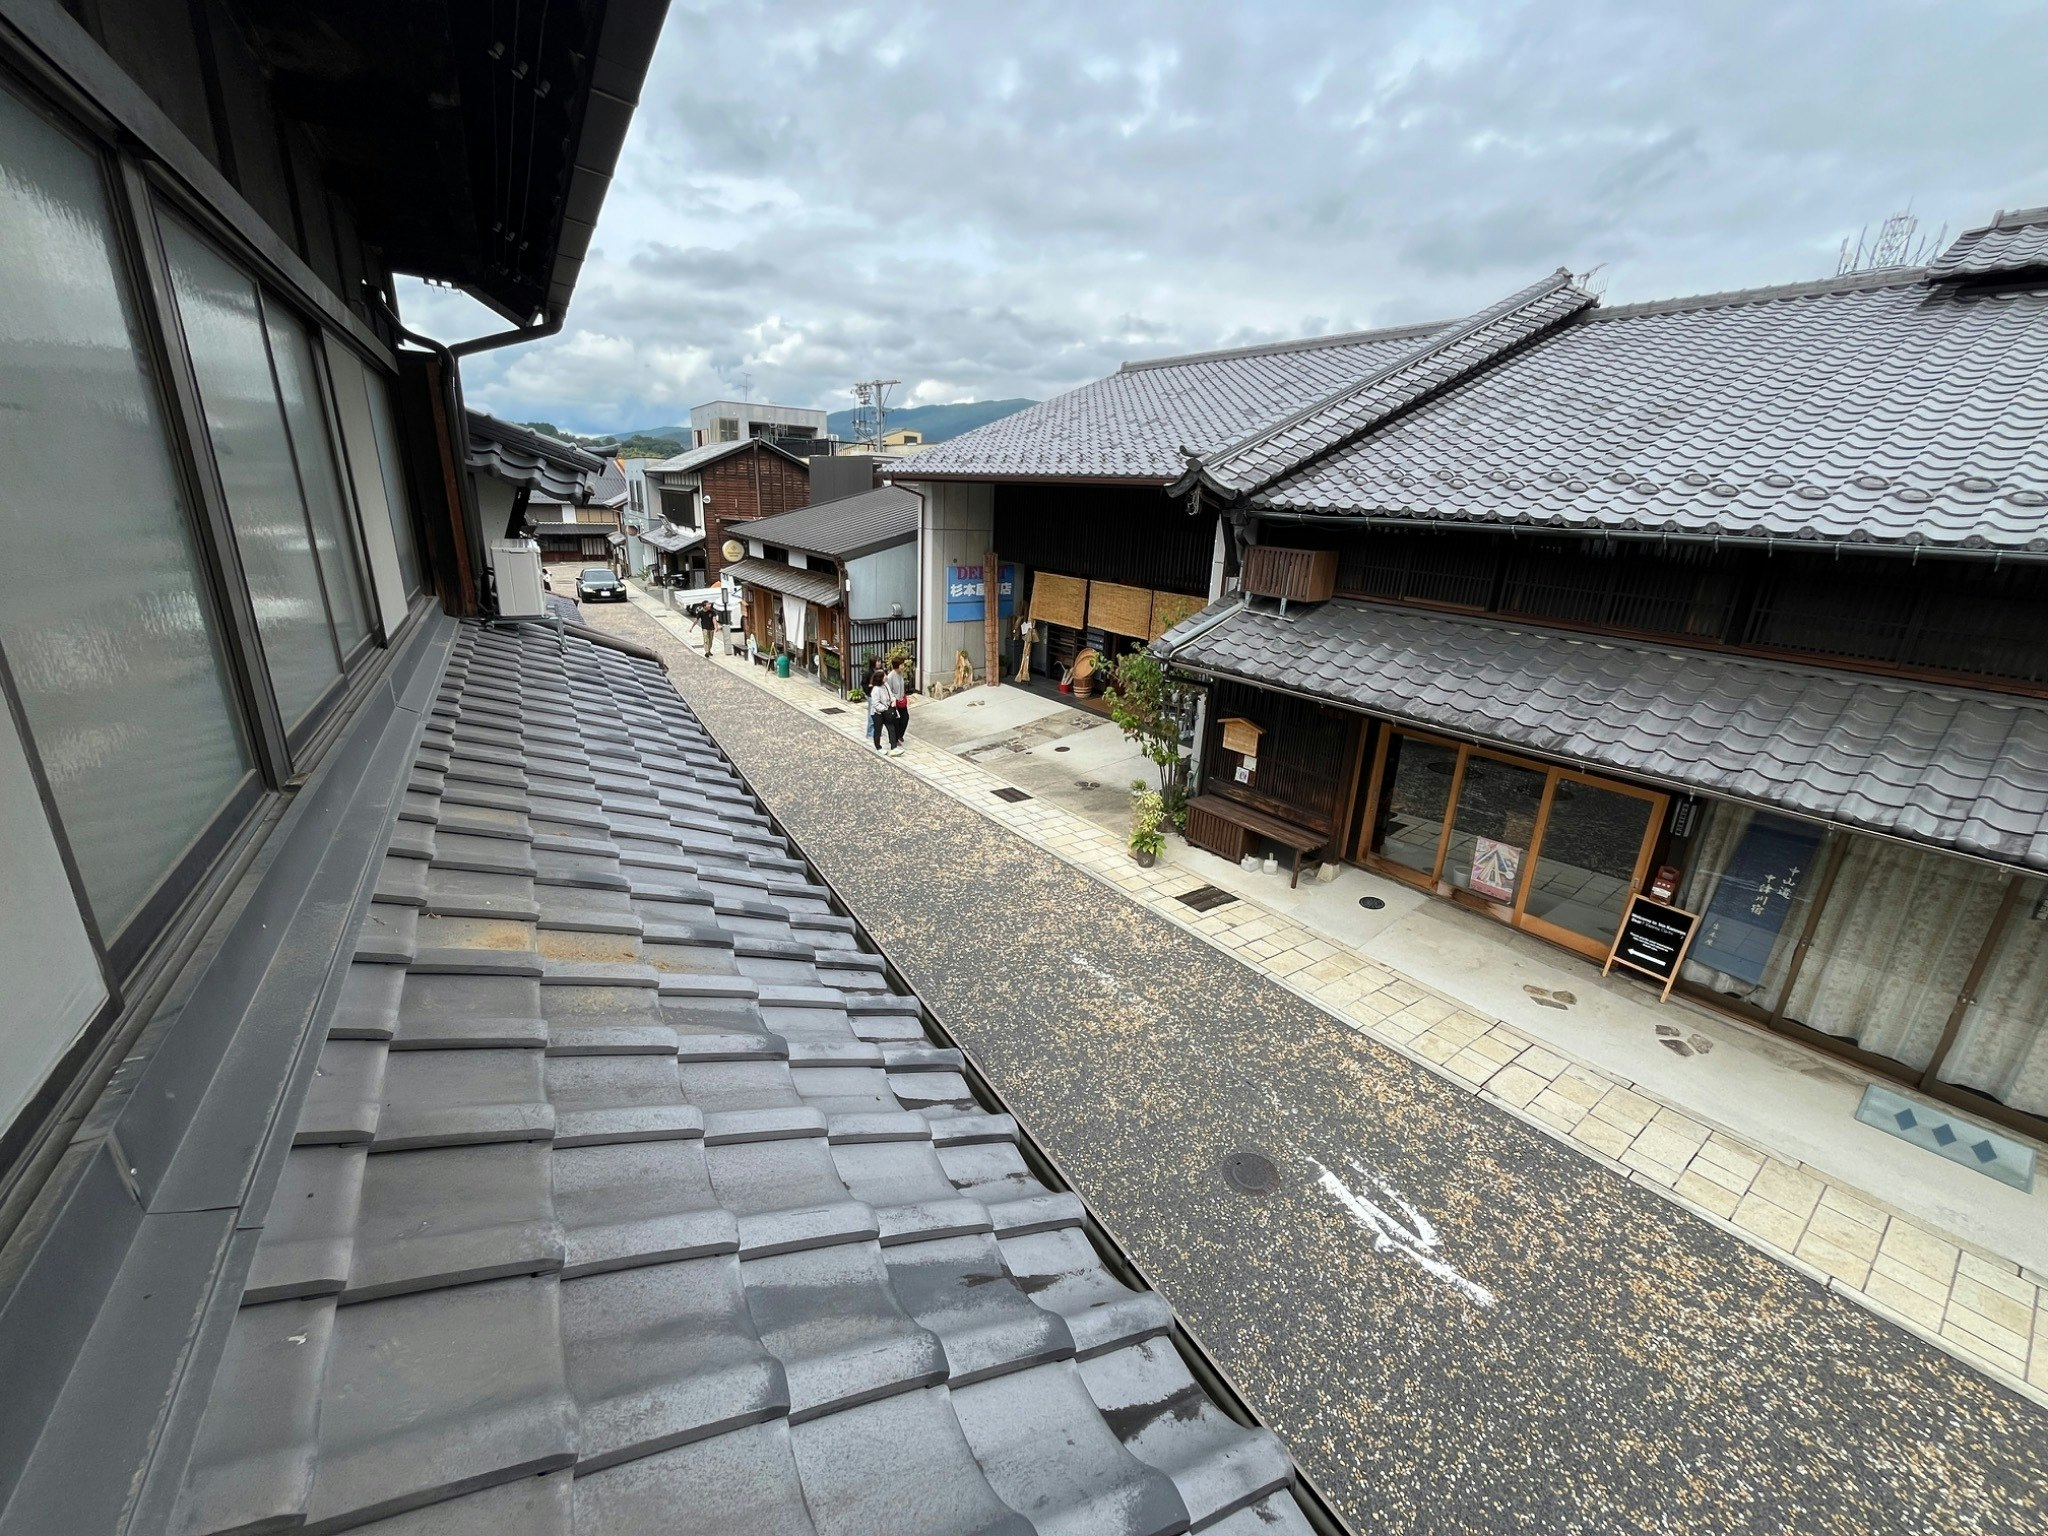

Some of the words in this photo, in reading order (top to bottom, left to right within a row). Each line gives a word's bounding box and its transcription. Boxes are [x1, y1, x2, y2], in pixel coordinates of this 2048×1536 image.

[956, 566, 1008, 580] DET
[950, 582, 1012, 597] 杉本屋店
